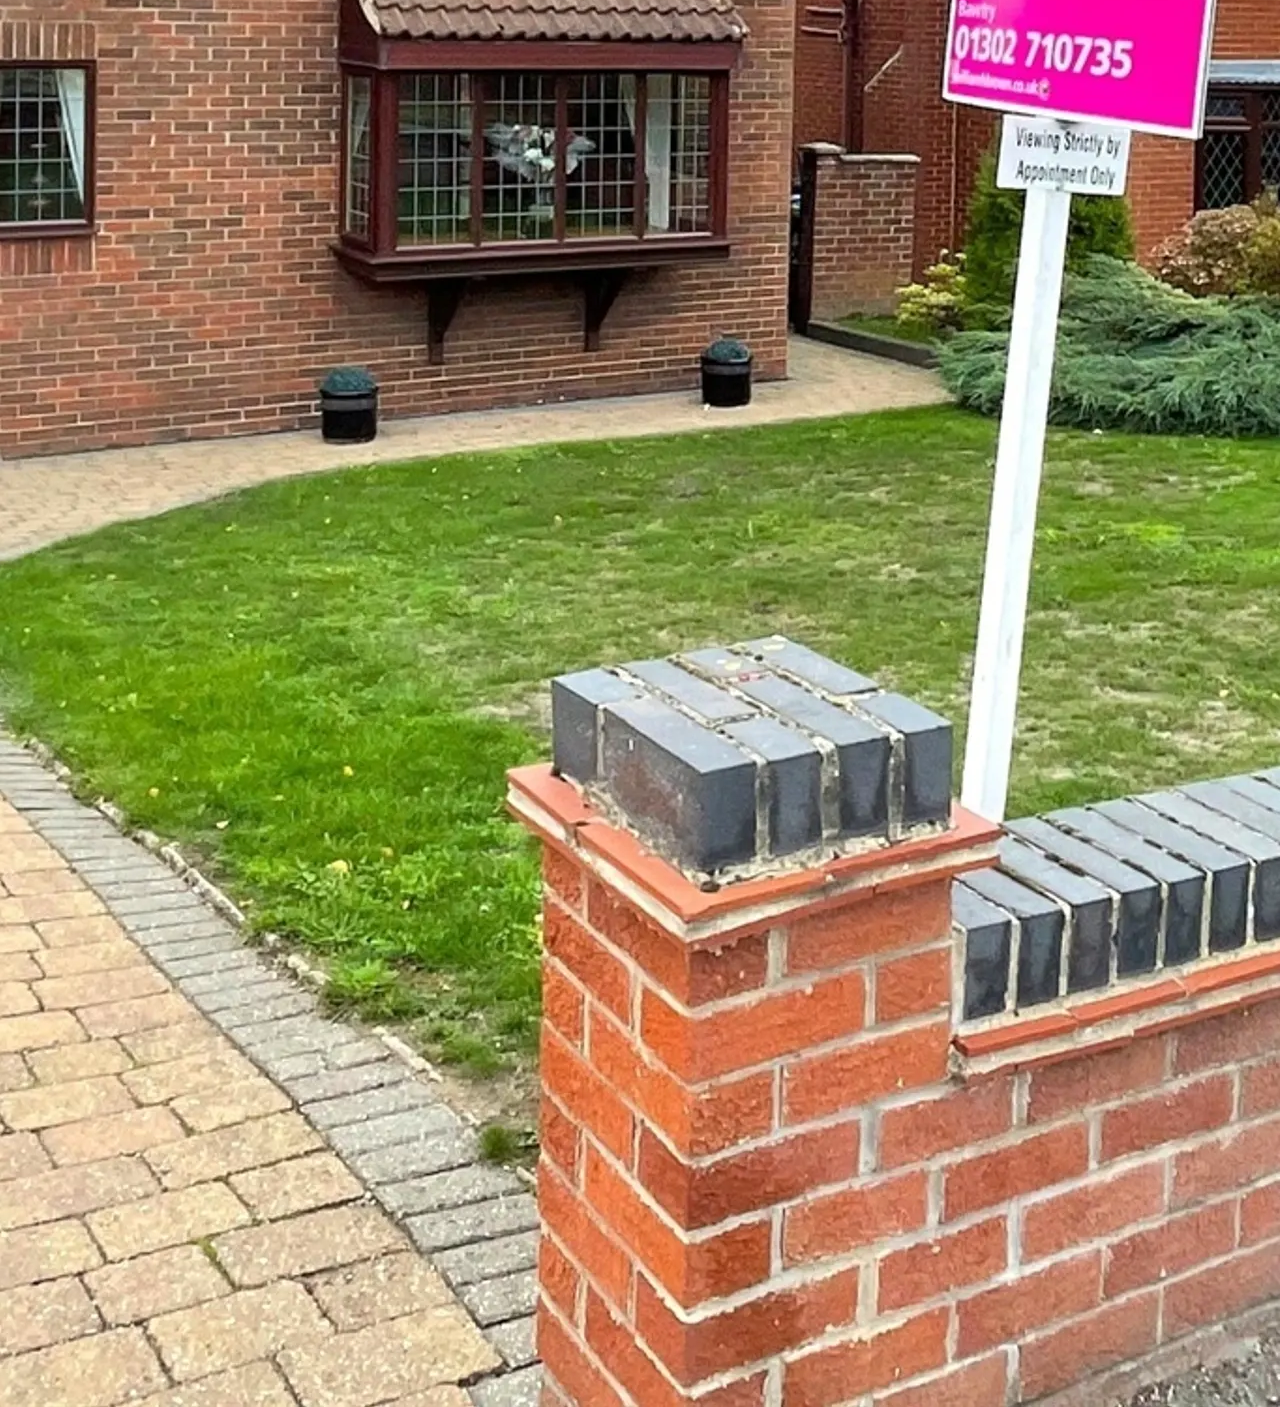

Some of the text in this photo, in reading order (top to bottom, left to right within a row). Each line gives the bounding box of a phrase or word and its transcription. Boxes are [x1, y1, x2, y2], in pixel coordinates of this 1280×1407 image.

[954, 24, 1134, 79] 01302 710735
[1016, 126, 1121, 159] Viewing Strictly by
[1015, 159, 1115, 190] Appointment Only
